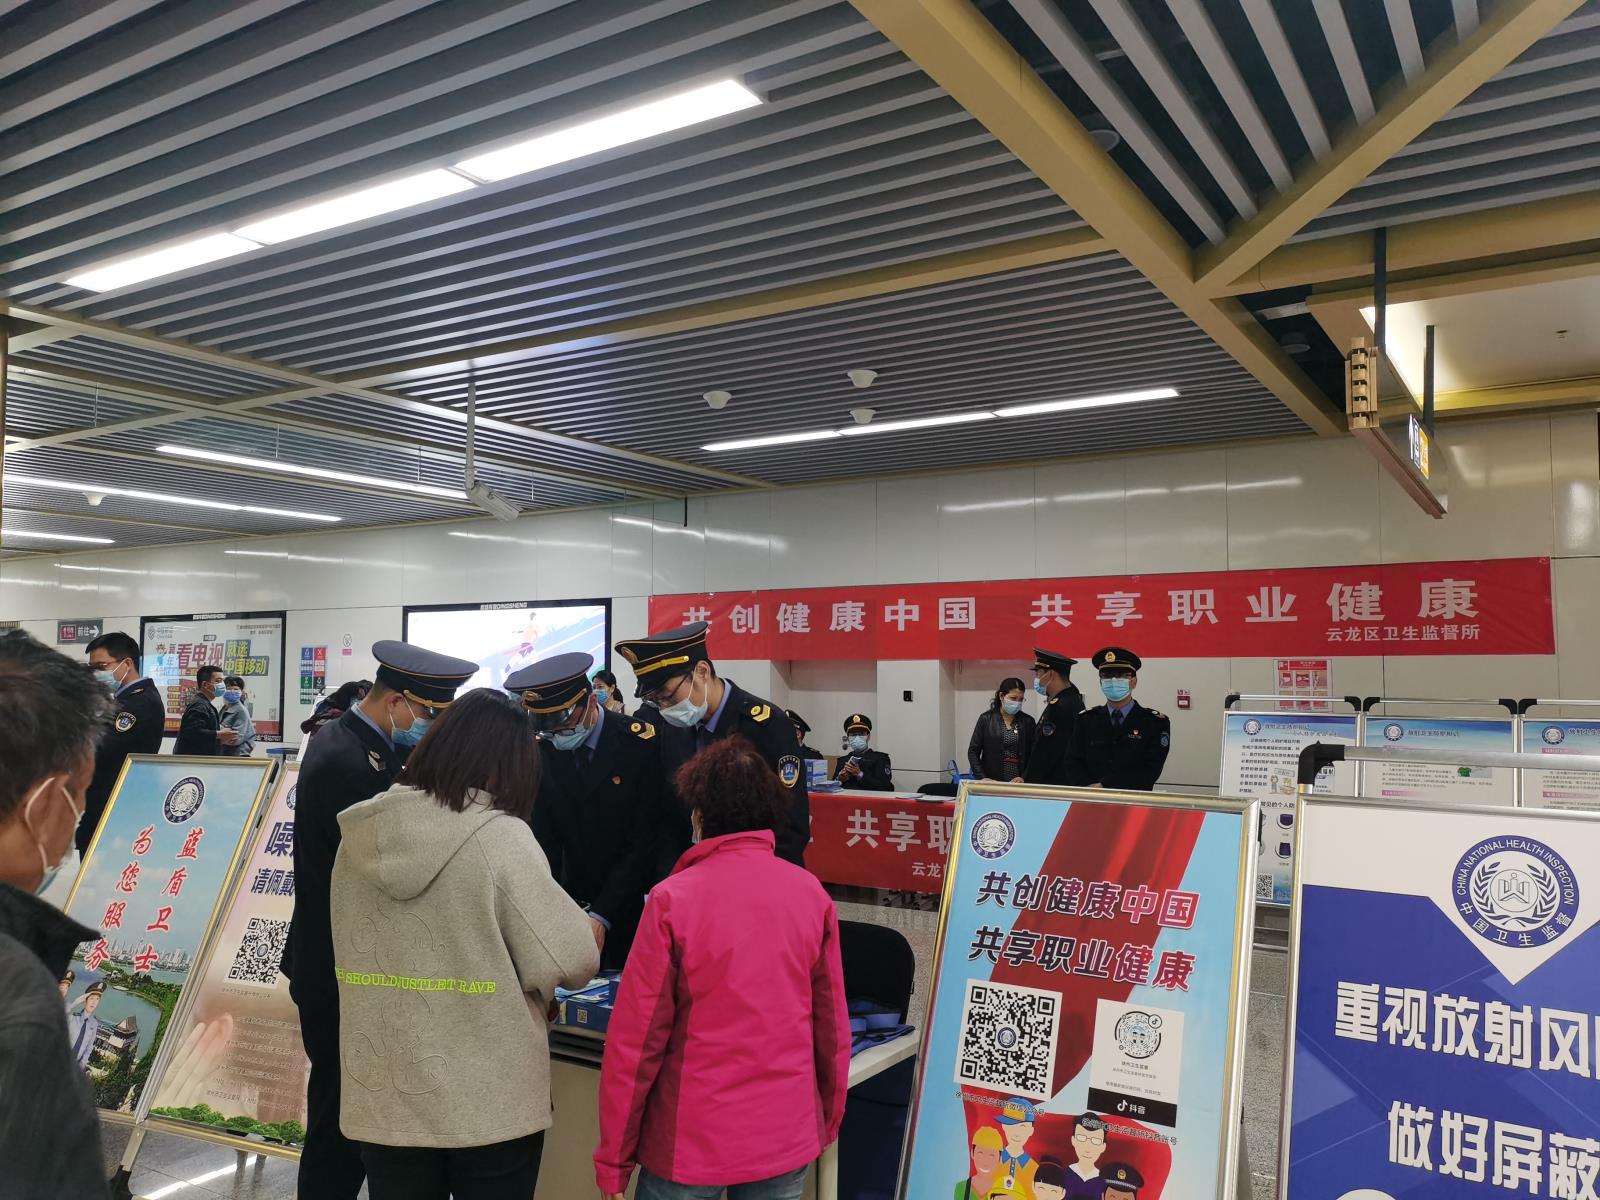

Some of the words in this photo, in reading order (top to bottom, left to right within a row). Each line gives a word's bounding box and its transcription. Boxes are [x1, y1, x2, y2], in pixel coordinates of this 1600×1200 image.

[682, 597, 976, 634] 共创健康中国
[1030, 578, 1480, 629] 共享职业健康
[177, 642, 225, 670] 看电视
[1325, 624, 1482, 643] 云龙区卫生监督所
[224, 658, 267, 675] 中国移动
[264, 821, 295, 857] 噪
[911, 863, 948, 878] 云龙
[1456, 868, 1469, 896] CHINA
[1464, 840, 1505, 869] NATIONAL
[1506, 839, 1545, 857] HEALTH
[1542, 851, 1575, 906] INSPECTION
[84, 824, 156, 972] 为您服务
[133, 826, 204, 973] 蓝盾卫士
[976, 870, 1200, 930] 共创健康中国
[1460, 902, 1573, 946] 中国卫生监督
[968, 926, 1197, 991] 共享职业健康
[458, 980, 497, 993] RAVE
[1335, 981, 1600, 1080] 重视放射风
[1129, 1103, 1146, 1115] 抖音
[1388, 1100, 1600, 1200] 做好屏蔽
